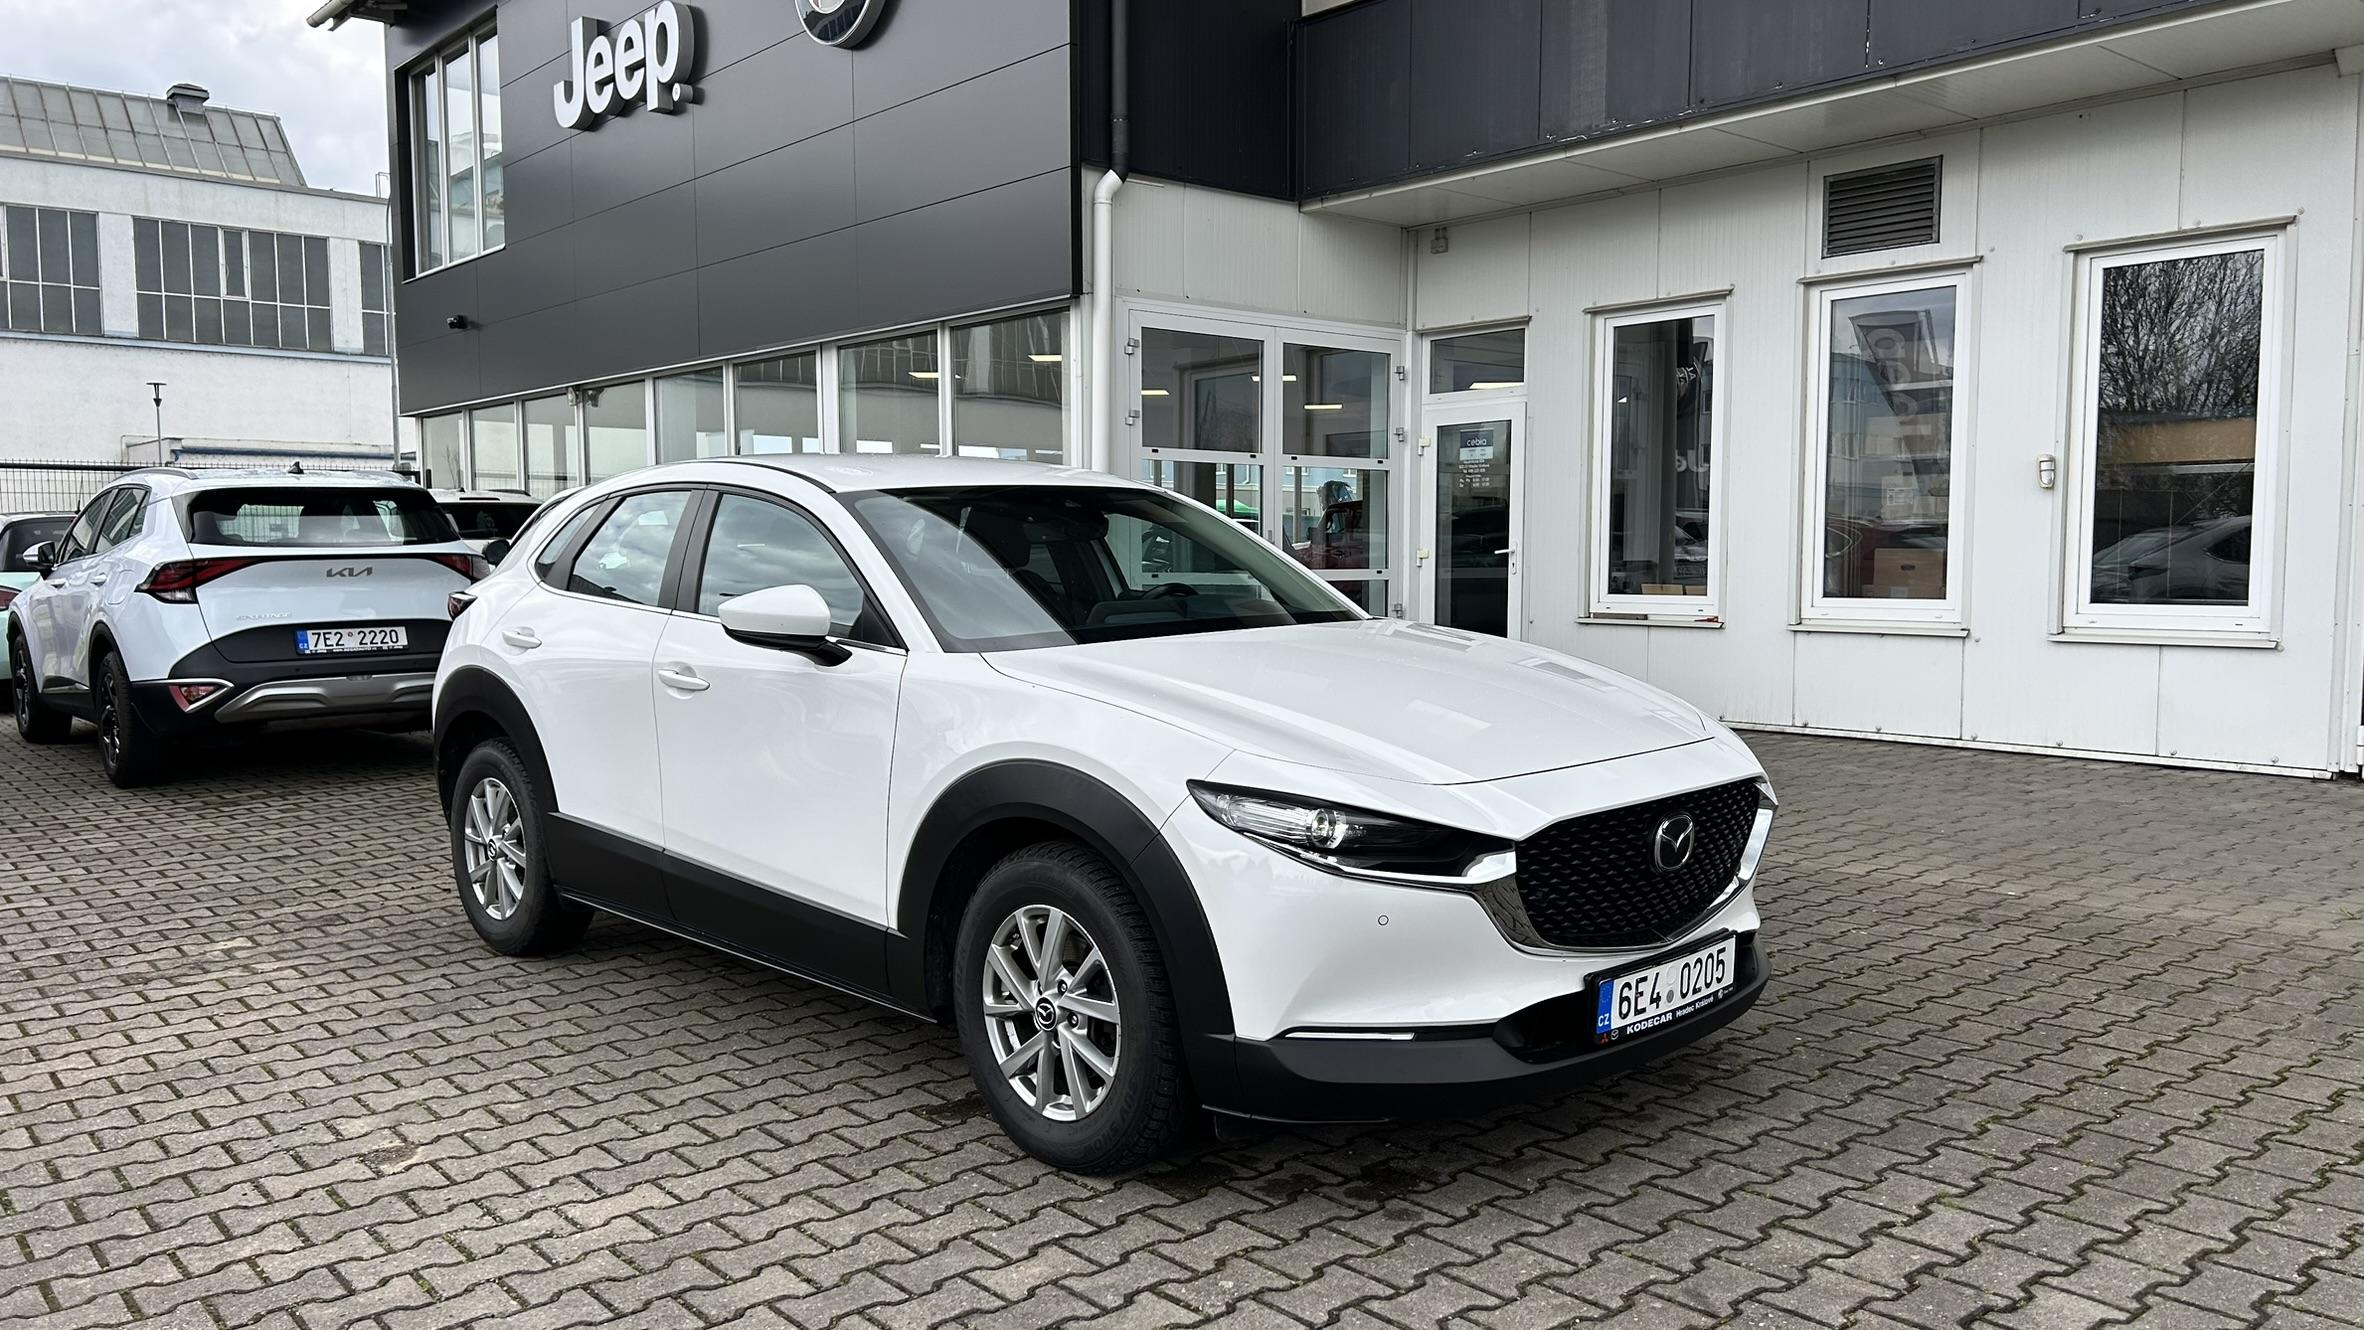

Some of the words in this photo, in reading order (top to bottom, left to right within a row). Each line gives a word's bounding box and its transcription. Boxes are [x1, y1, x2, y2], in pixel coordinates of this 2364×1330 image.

[553, 0, 679, 128] Jeep
[311, 631, 345, 648] 7E2
[357, 629, 399, 646] 2220
[1618, 972, 1661, 1020] 6E4
[1680, 947, 1726, 999] 0205
[1597, 1013, 1610, 1027] CZ
[1626, 1012, 1672, 1034] KODECAR
[1676, 1004, 1694, 1018] Hradec
